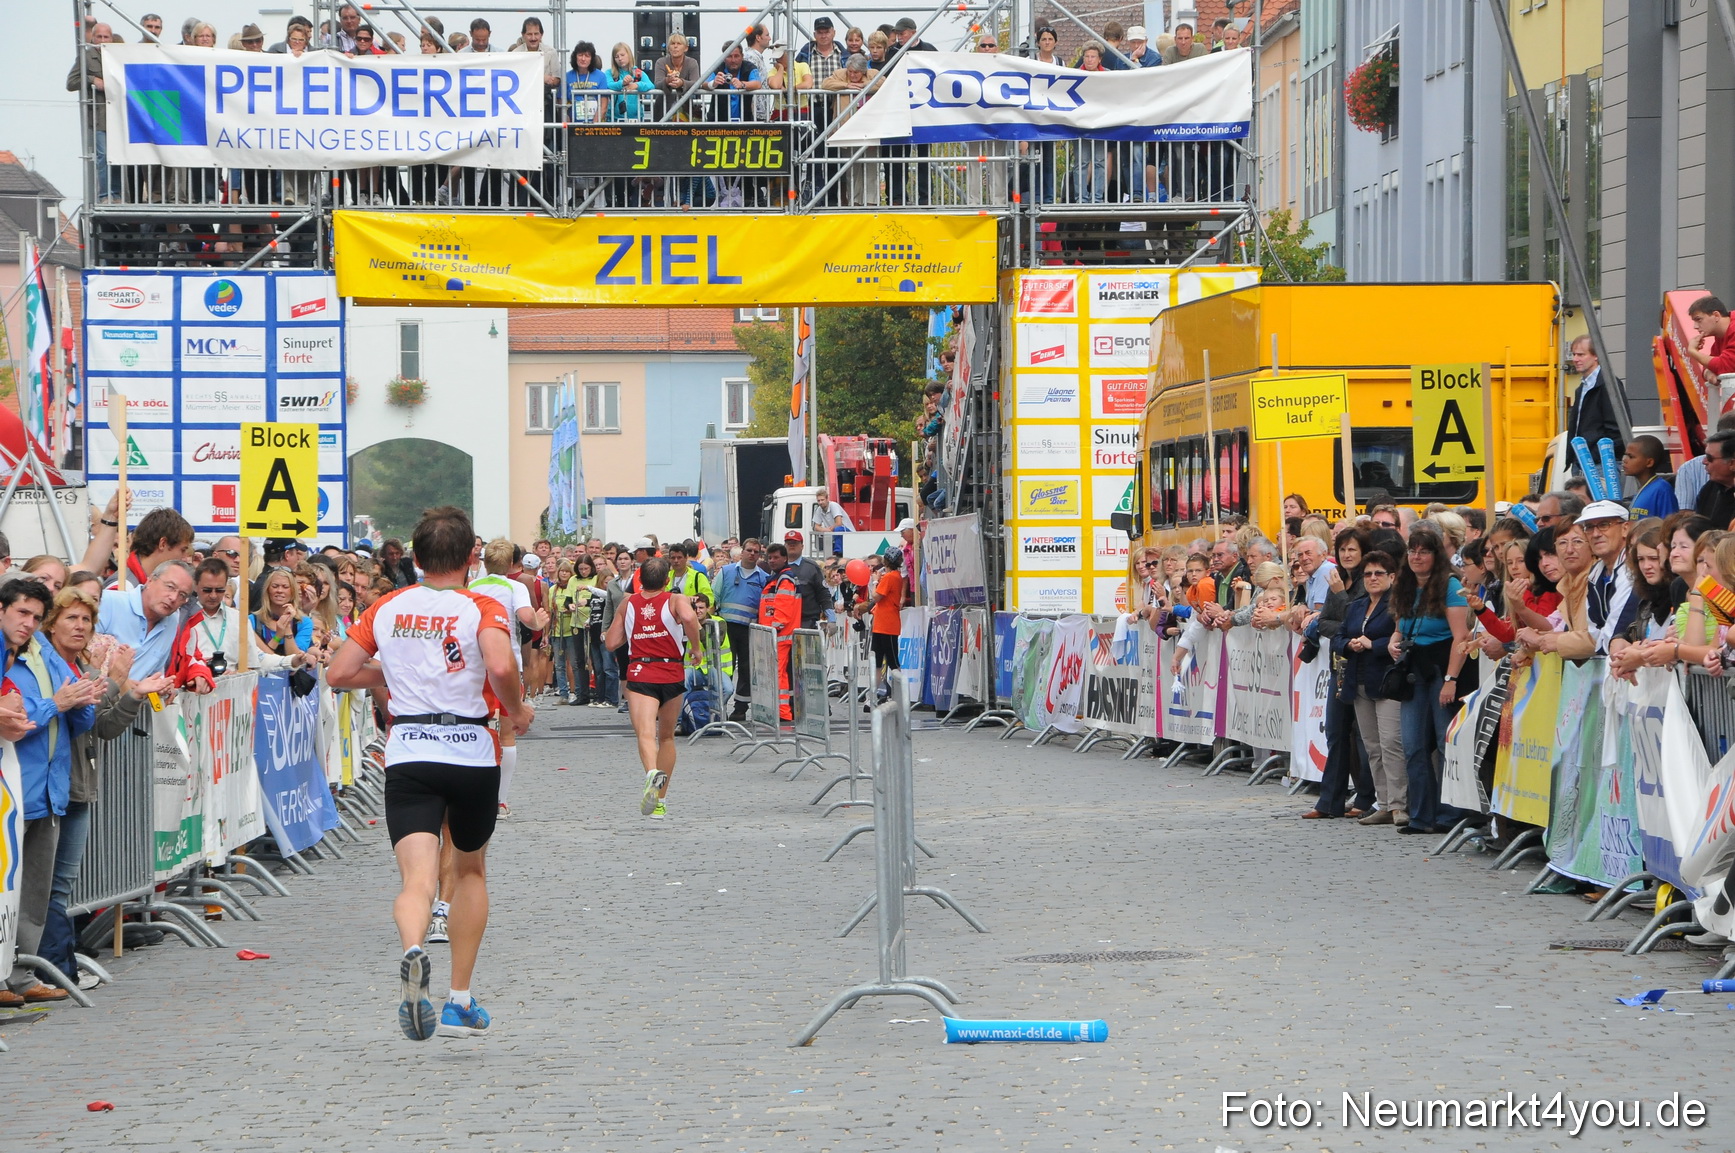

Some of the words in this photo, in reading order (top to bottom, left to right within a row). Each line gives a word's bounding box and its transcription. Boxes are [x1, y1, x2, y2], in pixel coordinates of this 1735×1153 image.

[216, 64, 523, 118] PFLEIDERER
[906, 68, 1088, 112] BOCK
[640, 128, 689, 136] Elektronische
[1153, 125, 1242, 136] www.bockonline.de
[216, 127, 523, 151] AKTIENGESELLSCHAFT
[632, 136, 651, 169] 3
[690, 136, 783, 169] 1:30:06
[369, 257, 447, 272] Neumarkter
[450, 261, 512, 275] Stadtlauf
[595, 235, 742, 285] ZIEL
[823, 261, 900, 274] Neumarkter
[903, 261, 963, 275] Stadtlauf
[1108, 281, 1159, 290] INTERSPORT
[1100, 290, 1159, 301] HACKNER
[208, 303, 237, 313] vedes
[186, 338, 237, 354] MCM
[283, 337, 333, 351] Sinupret
[283, 352, 313, 364] forte
[1123, 382, 1138, 390] FÜR
[1139, 382, 1148, 390] SI
[1421, 368, 1481, 390] Block
[1048, 387, 1075, 396] Wagner
[142, 399, 168, 408] BÖGL
[280, 396, 319, 407] swn
[1257, 394, 1340, 409] Schnupper-
[1286, 410, 1313, 424] lauf
[1430, 399, 1476, 456] A
[251, 426, 311, 449] Block
[1094, 449, 1136, 465] forte
[256, 457, 301, 513] A
[1030, 485, 1068, 505] Glossner
[1032, 536, 1076, 544] INTERSPORT
[1024, 545, 1076, 553] HACKNER
[395, 614, 459, 631] MERZ
[391, 624, 444, 640] Reisen
[400, 731, 440, 742] TEAM
[443, 732, 478, 743] 2009
[958, 1027, 1062, 1039] www.maxi-dsl.de
